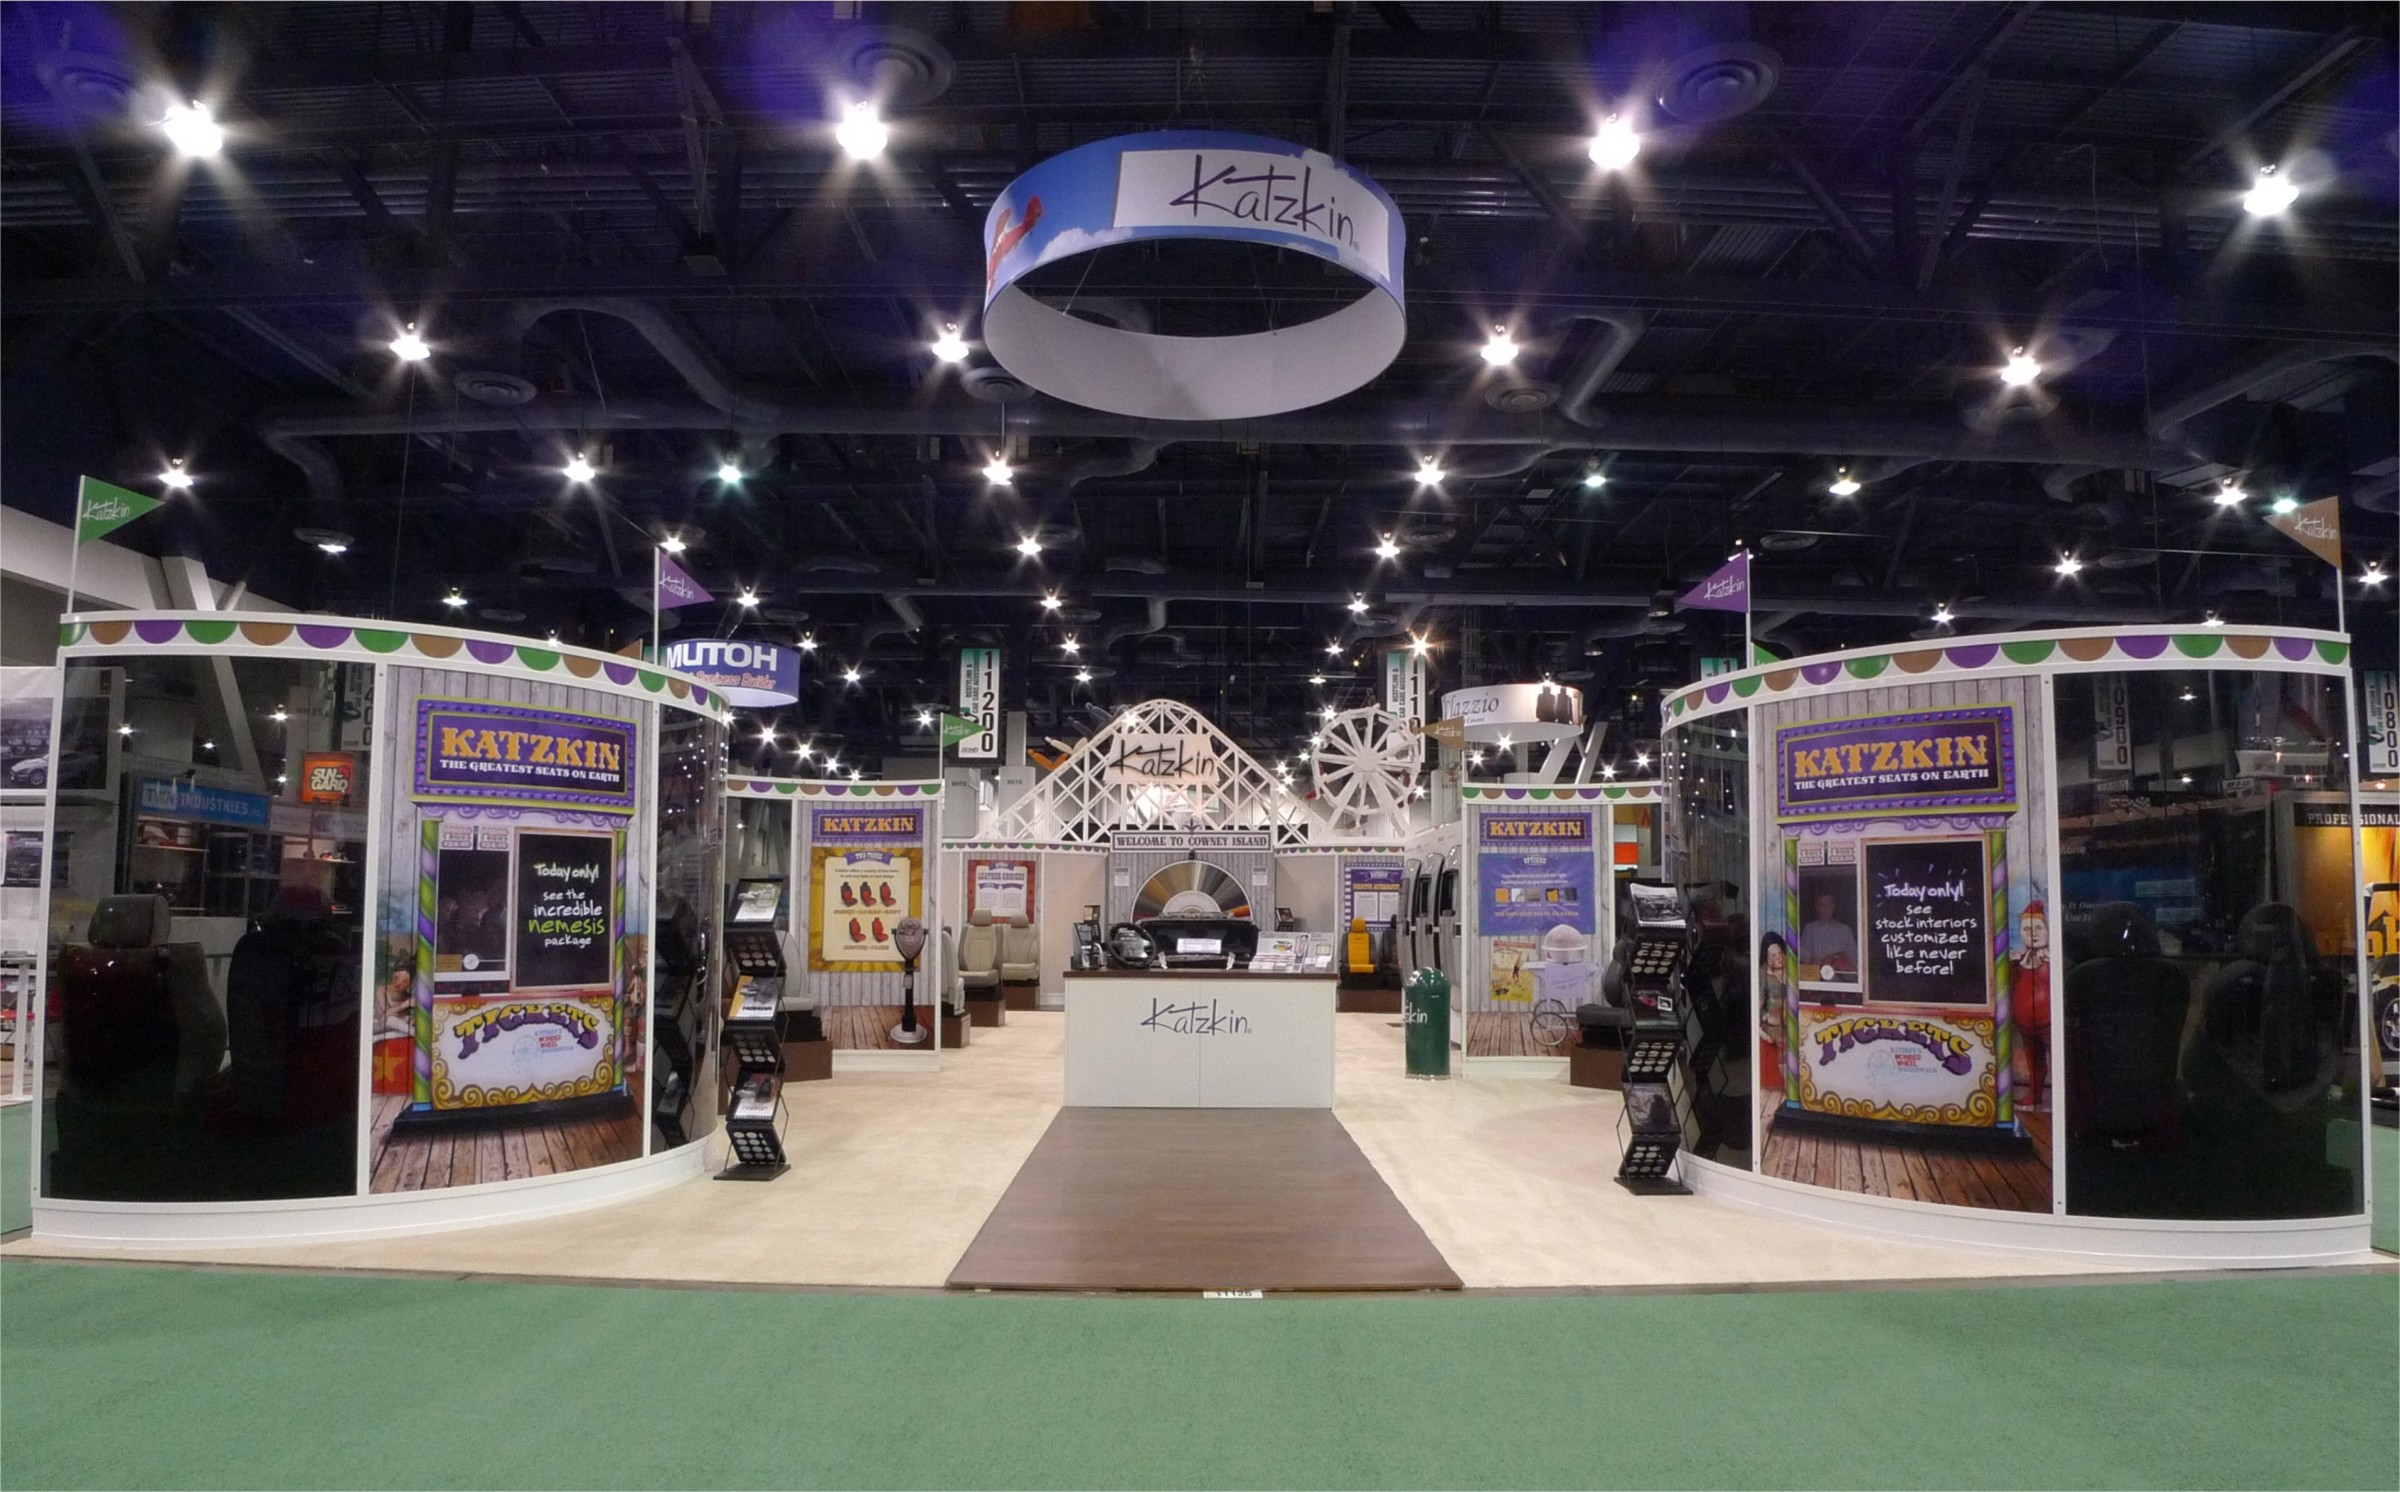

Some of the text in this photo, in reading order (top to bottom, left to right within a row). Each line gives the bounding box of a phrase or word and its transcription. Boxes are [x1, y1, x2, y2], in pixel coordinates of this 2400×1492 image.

[1169, 154, 1357, 249] Katzkin
[82, 497, 131, 521] Katzkin
[2293, 512, 2337, 540] Katzkin
[1703, 575, 1745, 600] Katzkin
[666, 642, 778, 672] MUTOH
[440, 727, 621, 771] KATZKIN
[1108, 739, 1217, 778] Katzkin
[1793, 734, 1989, 778] KATZKIN
[440, 758, 620, 783] THE GREATEST SEATS ON EARTH
[1794, 769, 1989, 790] THE GREATEST SEATS ON EARTH
[823, 817, 914, 833] KATZKIN
[1490, 821, 1582, 836] KATZKIN
[2308, 813, 2399, 826] PROFESIONAL
[1116, 836, 1267, 847] WELCOME TO COWNEY ISLAND
[534, 863, 599, 883] Today only!
[543, 888, 585, 901] see the
[1884, 880, 1964, 902] Today only!
[534, 900, 602, 917] incredible
[1906, 905, 1932, 915] see
[528, 918, 605, 935] nemesis
[1875, 916, 1977, 930] stock interiors
[545, 935, 592, 949] package
[1881, 930, 1968, 944] customized
[1886, 944, 1967, 960] like never
[1896, 959, 1954, 976] before!
[1140, 997, 1250, 1036] Katzkin
[453, 1003, 600, 1060] TICKETS
[1815, 1017, 1974, 1076] TICKETS
